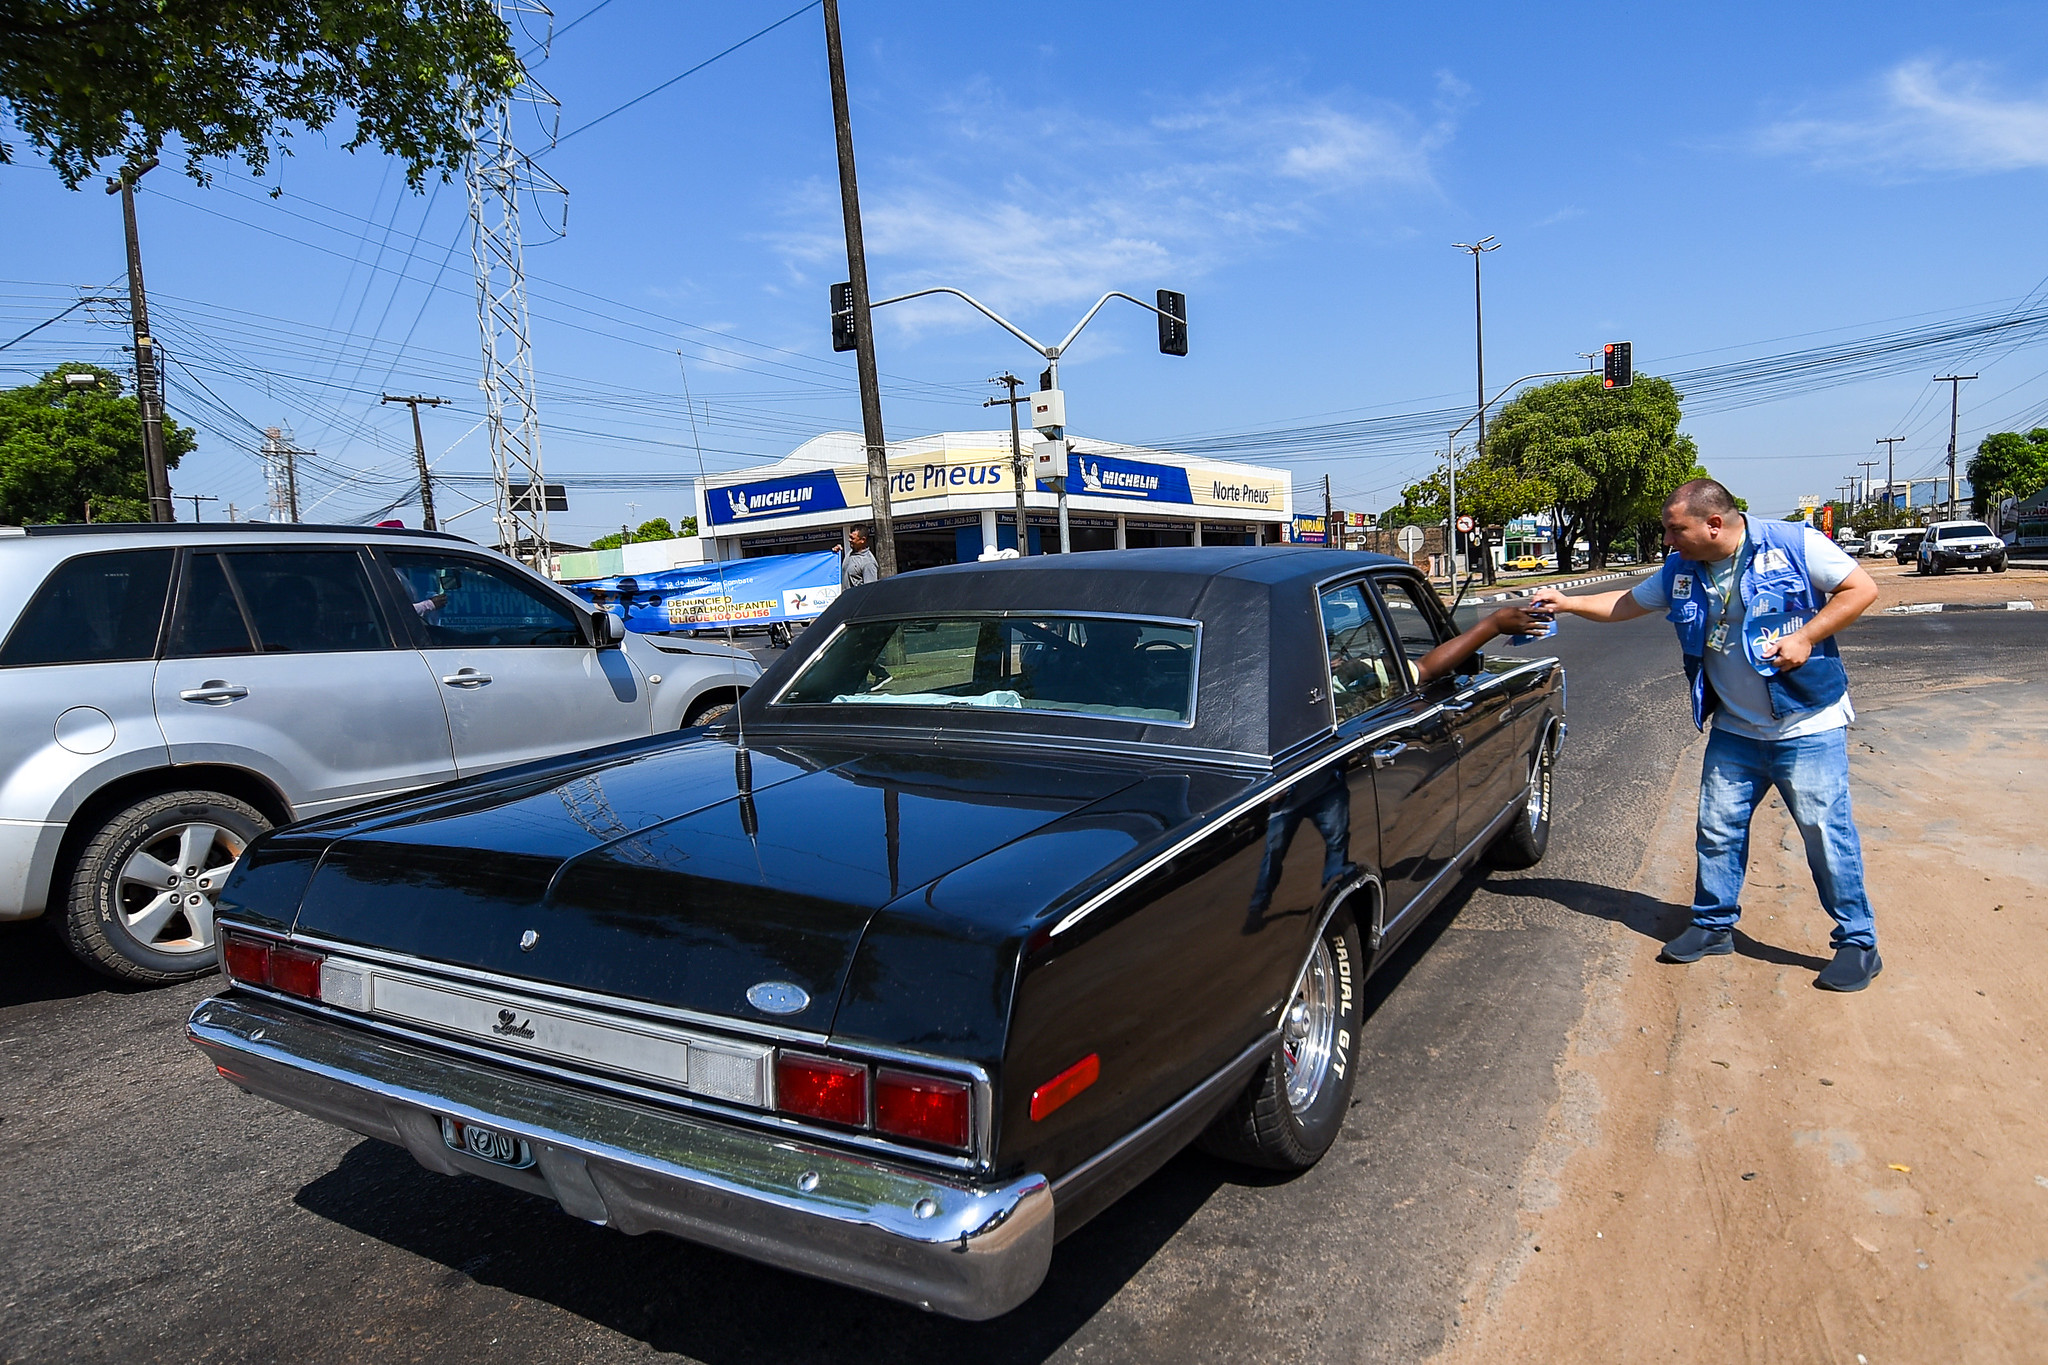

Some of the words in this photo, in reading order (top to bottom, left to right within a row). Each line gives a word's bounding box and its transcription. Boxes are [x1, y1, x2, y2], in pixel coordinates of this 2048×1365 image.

[924, 464, 1001, 489] Pneus
[1102, 470, 1158, 489] MICHELIN
[749, 487, 813, 508] MICHELIN
[1213, 481, 1240, 502] Norte
[1243, 484, 1269, 504] Pneus
[722, 577, 754, 586] Combate
[668, 596, 721, 607] DENUNCIE
[724, 596, 733, 604] O
[668, 604, 726, 616] TRABALHO
[728, 600, 777, 612] INFANTIL:
[680, 614, 710, 624] LIGUE
[713, 613, 732, 621] 100
[734, 611, 749, 619] OU
[753, 609, 770, 617] 156
[103, 839, 131, 880] Brutus
[130, 822, 150, 840] T/A
[1333, 935, 1353, 1018] RADIAL
[1333, 1028, 1351, 1080] G/T
